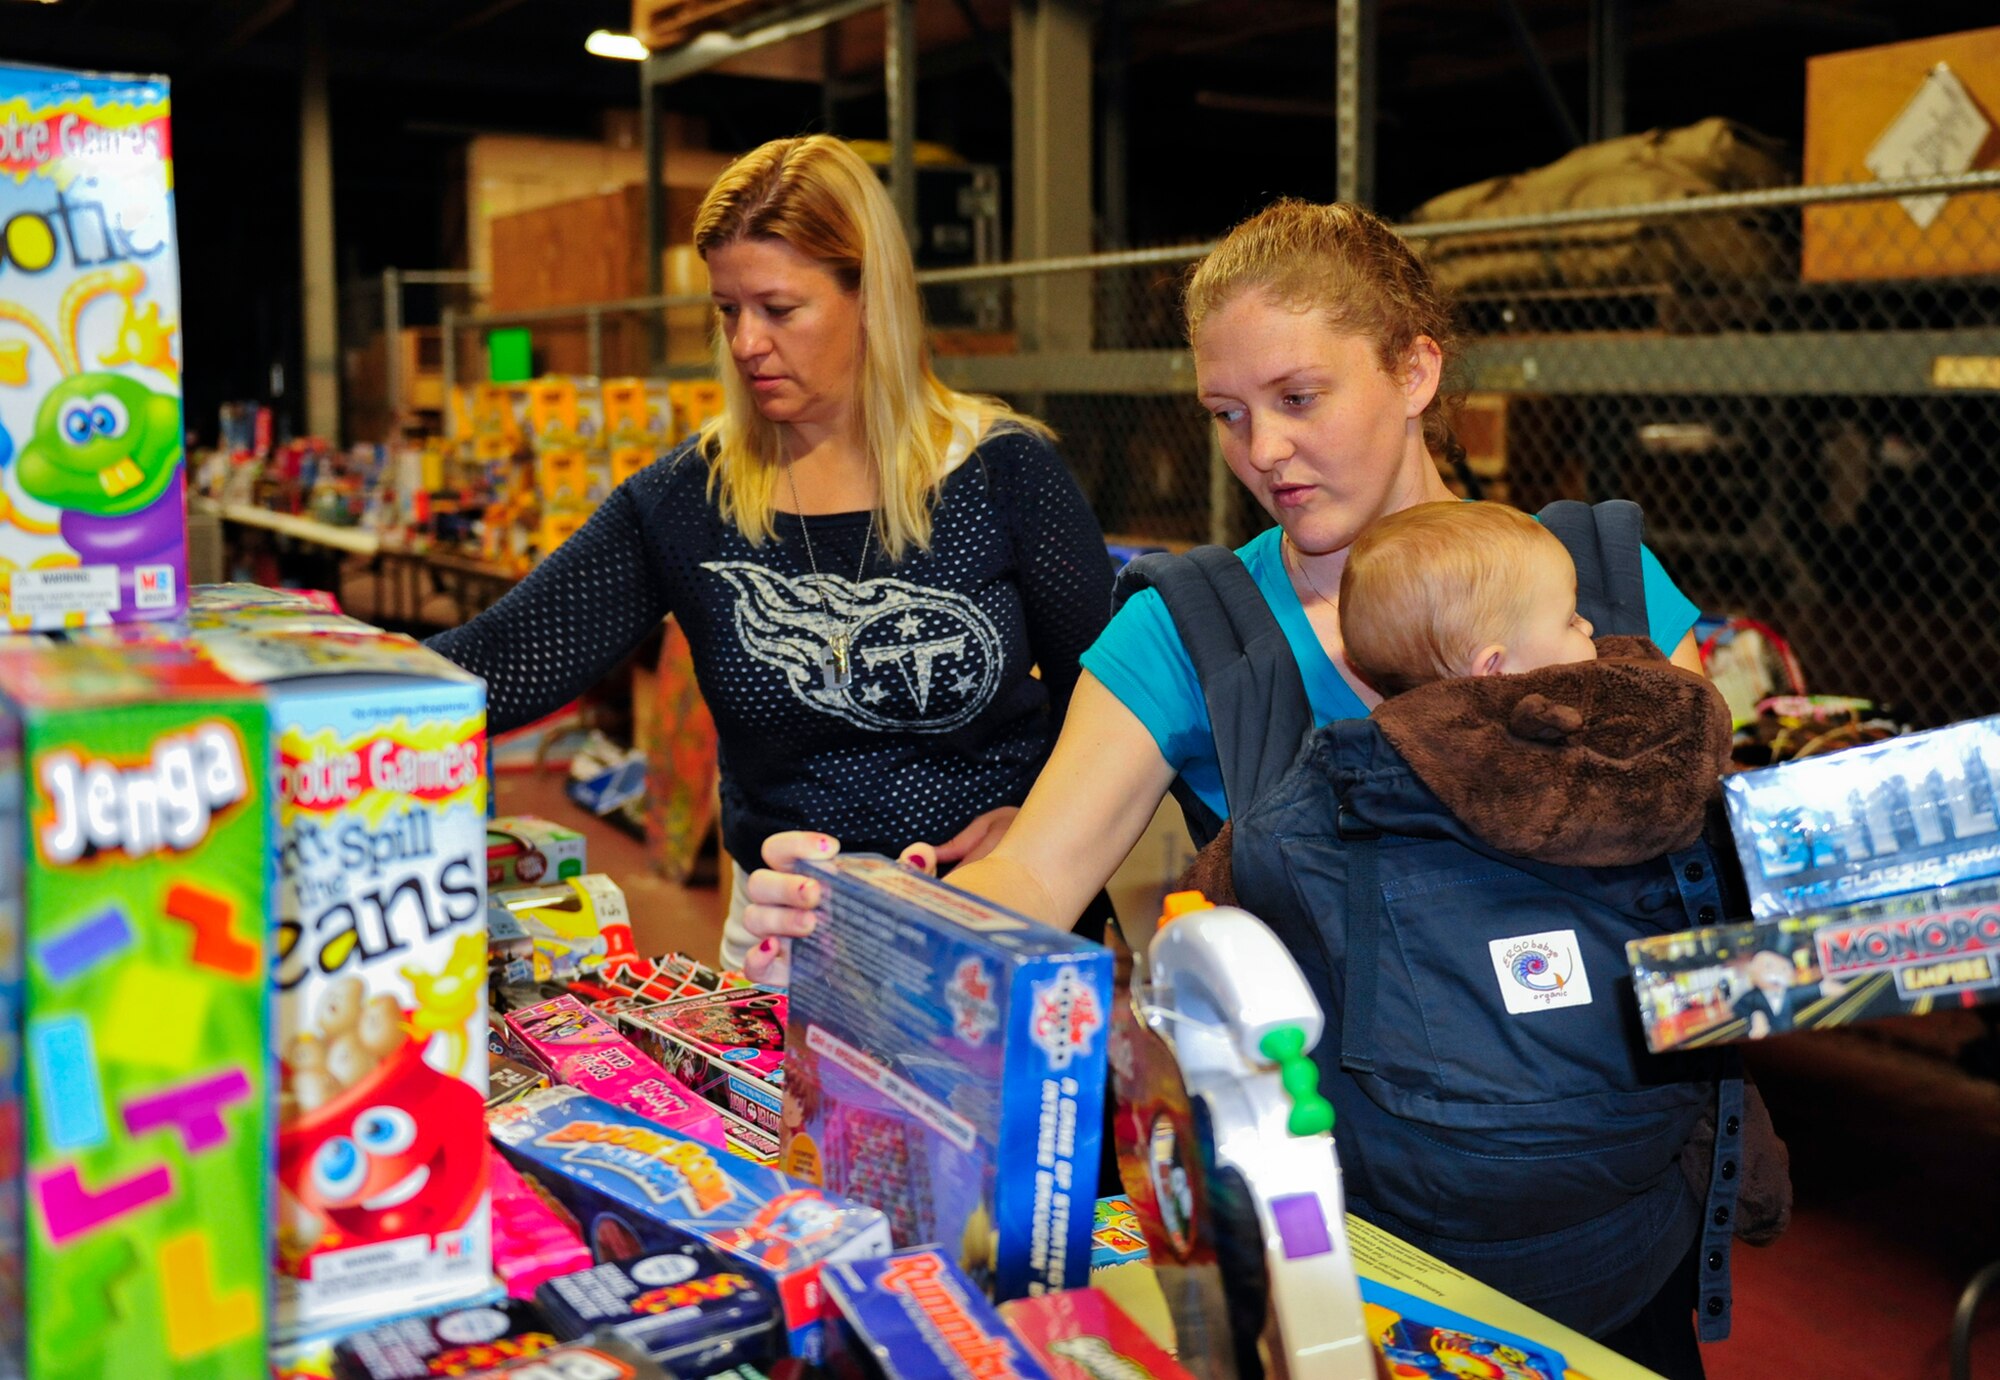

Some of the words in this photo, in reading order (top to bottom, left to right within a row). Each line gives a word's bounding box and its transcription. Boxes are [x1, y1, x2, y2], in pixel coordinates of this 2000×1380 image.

[49, 725, 243, 860] Jenga
[368, 737, 479, 796] Games
[340, 806, 433, 876] Spill
[1533, 989, 1568, 1004] organic
[599, 1046, 635, 1070] GAME
